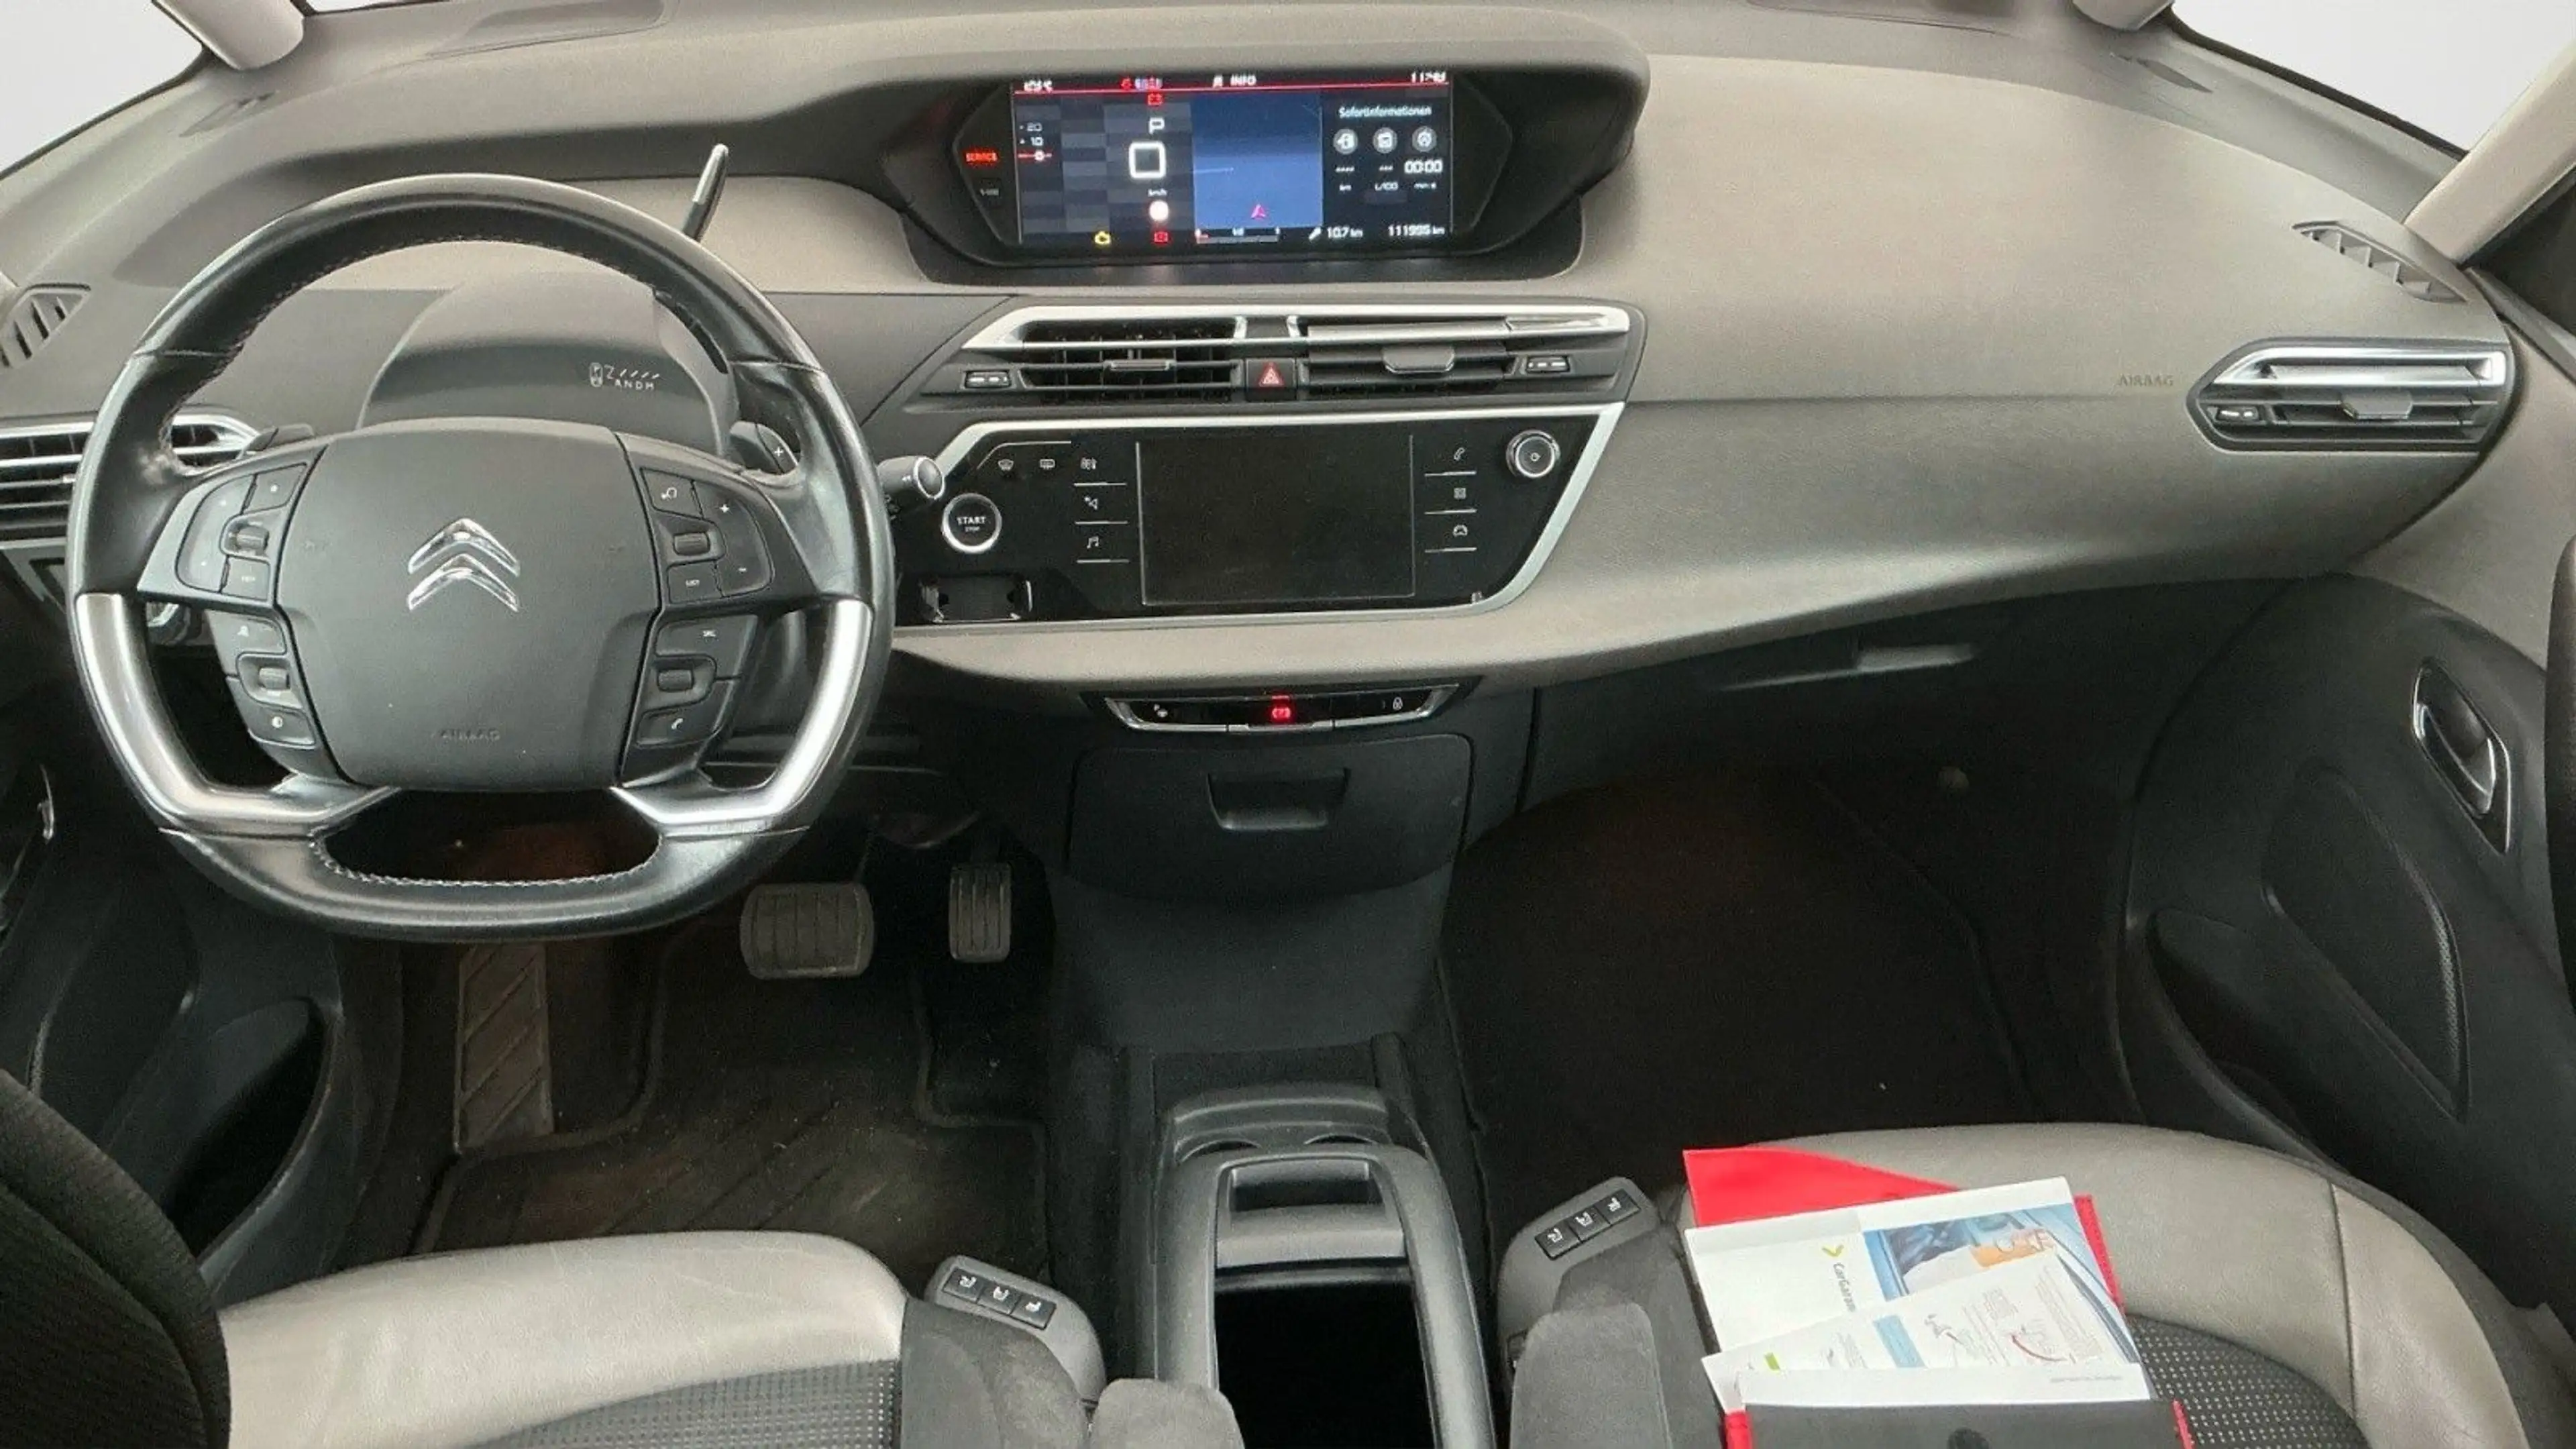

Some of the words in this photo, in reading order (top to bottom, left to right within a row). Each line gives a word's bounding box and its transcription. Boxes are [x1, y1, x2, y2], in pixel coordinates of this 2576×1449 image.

[1149, 117, 1165, 134] P
[2118, 373, 2174, 387] AIRBAG
[957, 516, 986, 525] START
